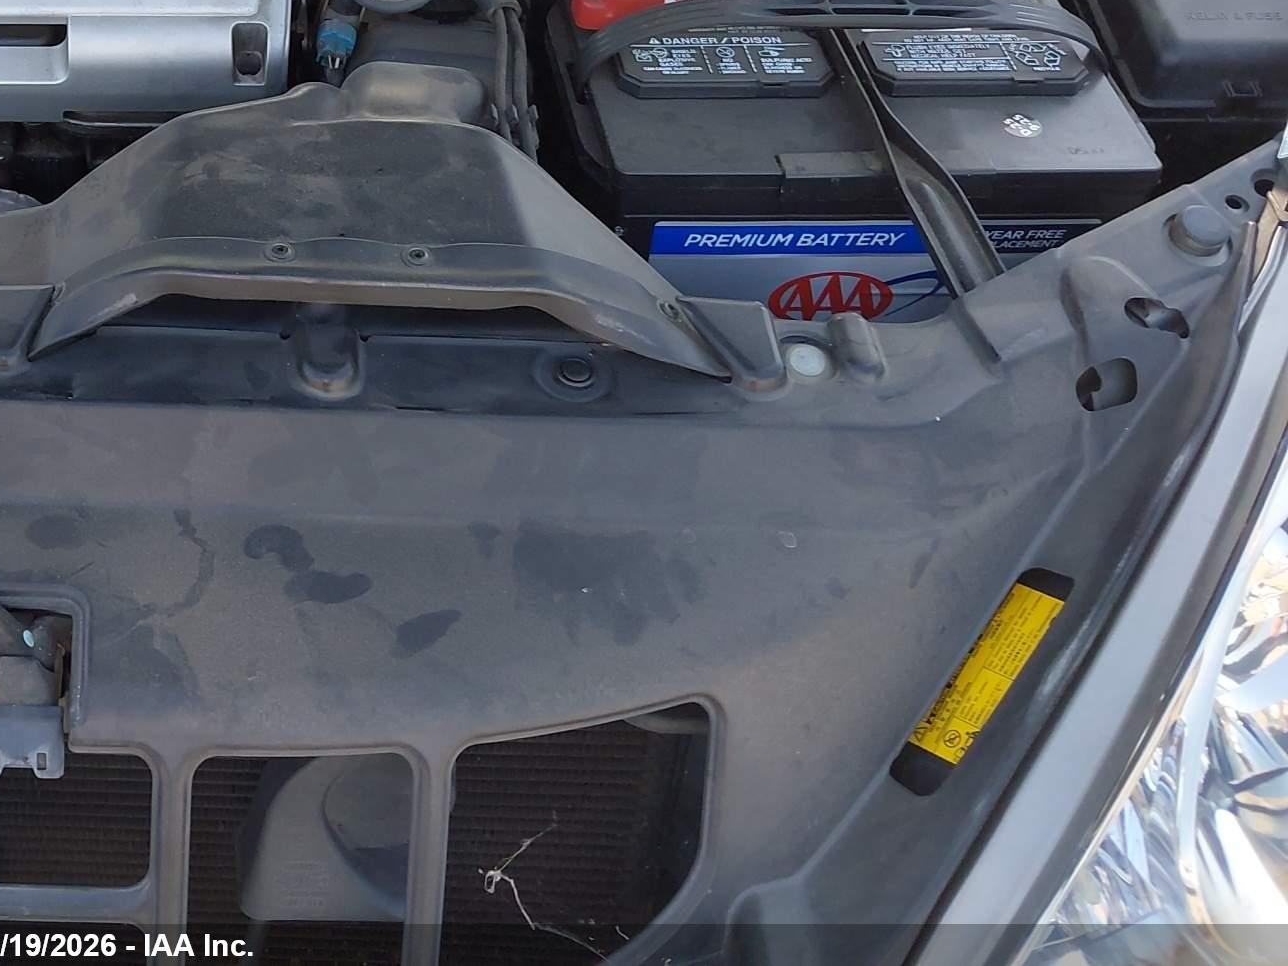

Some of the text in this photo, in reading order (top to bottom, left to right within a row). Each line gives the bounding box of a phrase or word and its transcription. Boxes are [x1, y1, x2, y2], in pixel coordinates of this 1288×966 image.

[662, 37, 719, 45] DANGER
[731, 36, 782, 44] POISON
[1025, 229, 1067, 239] FREE
[684, 232, 907, 248] PREMIUM BATTERY
[992, 239, 1059, 248] LACEMENT
[770, 272, 892, 321] AAA
